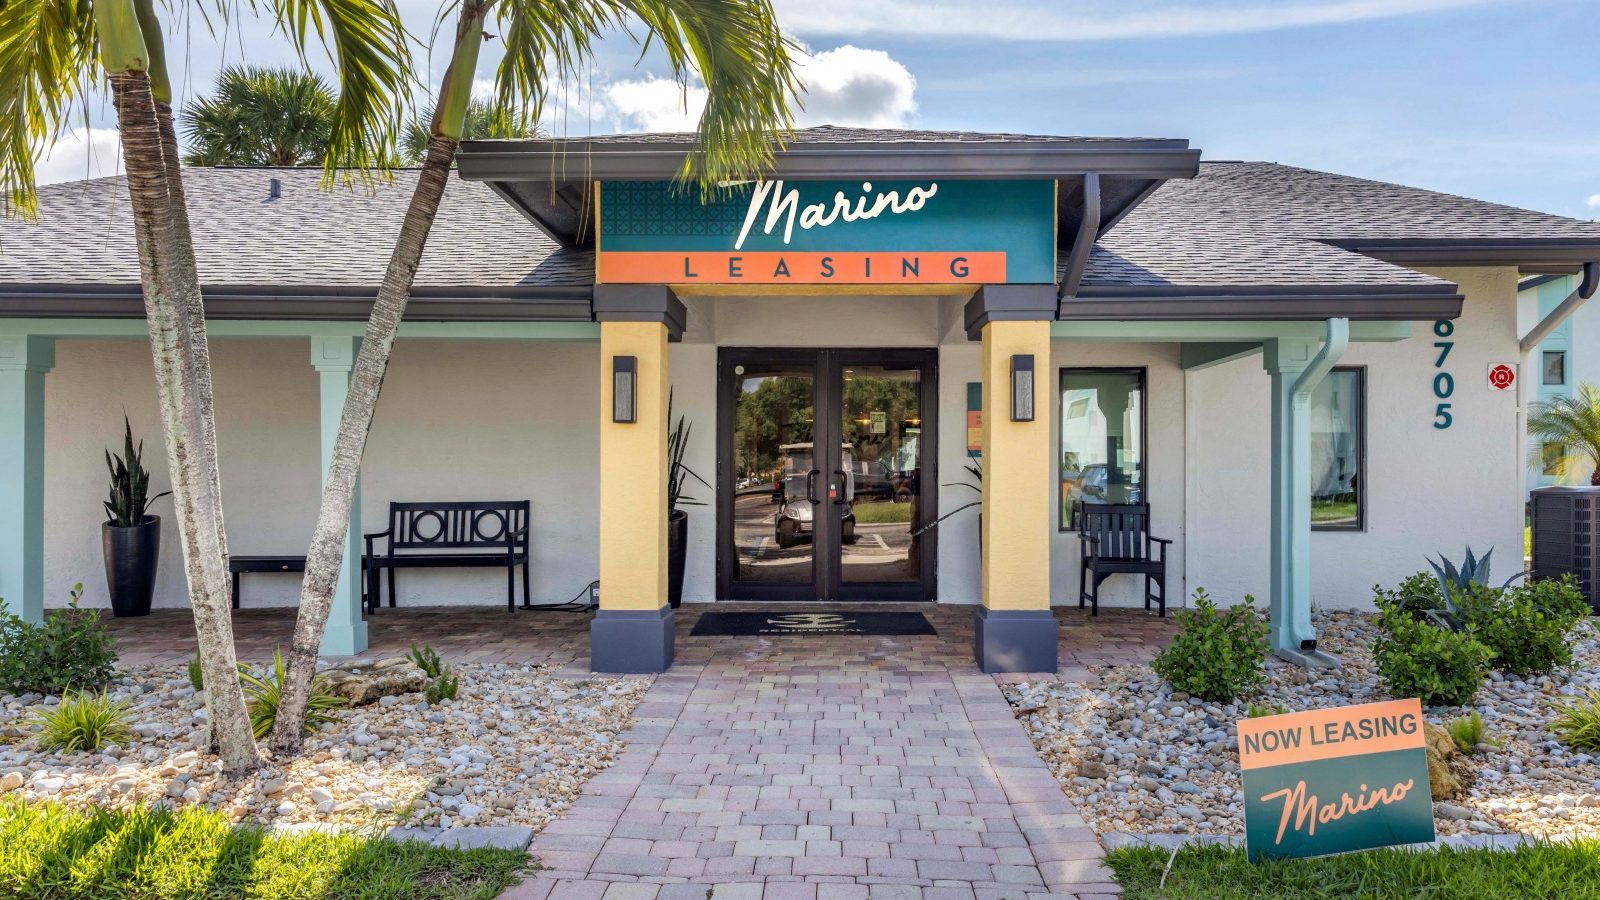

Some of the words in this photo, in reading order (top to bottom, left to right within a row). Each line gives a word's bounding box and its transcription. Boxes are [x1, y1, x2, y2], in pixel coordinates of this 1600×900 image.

[718, 180, 938, 250] Marino
[684, 256, 970, 279] LEASING
[1244, 727, 1302, 754] NOW
[1310, 713, 1418, 746] LEASING
[1260, 778, 1415, 845] Marino
